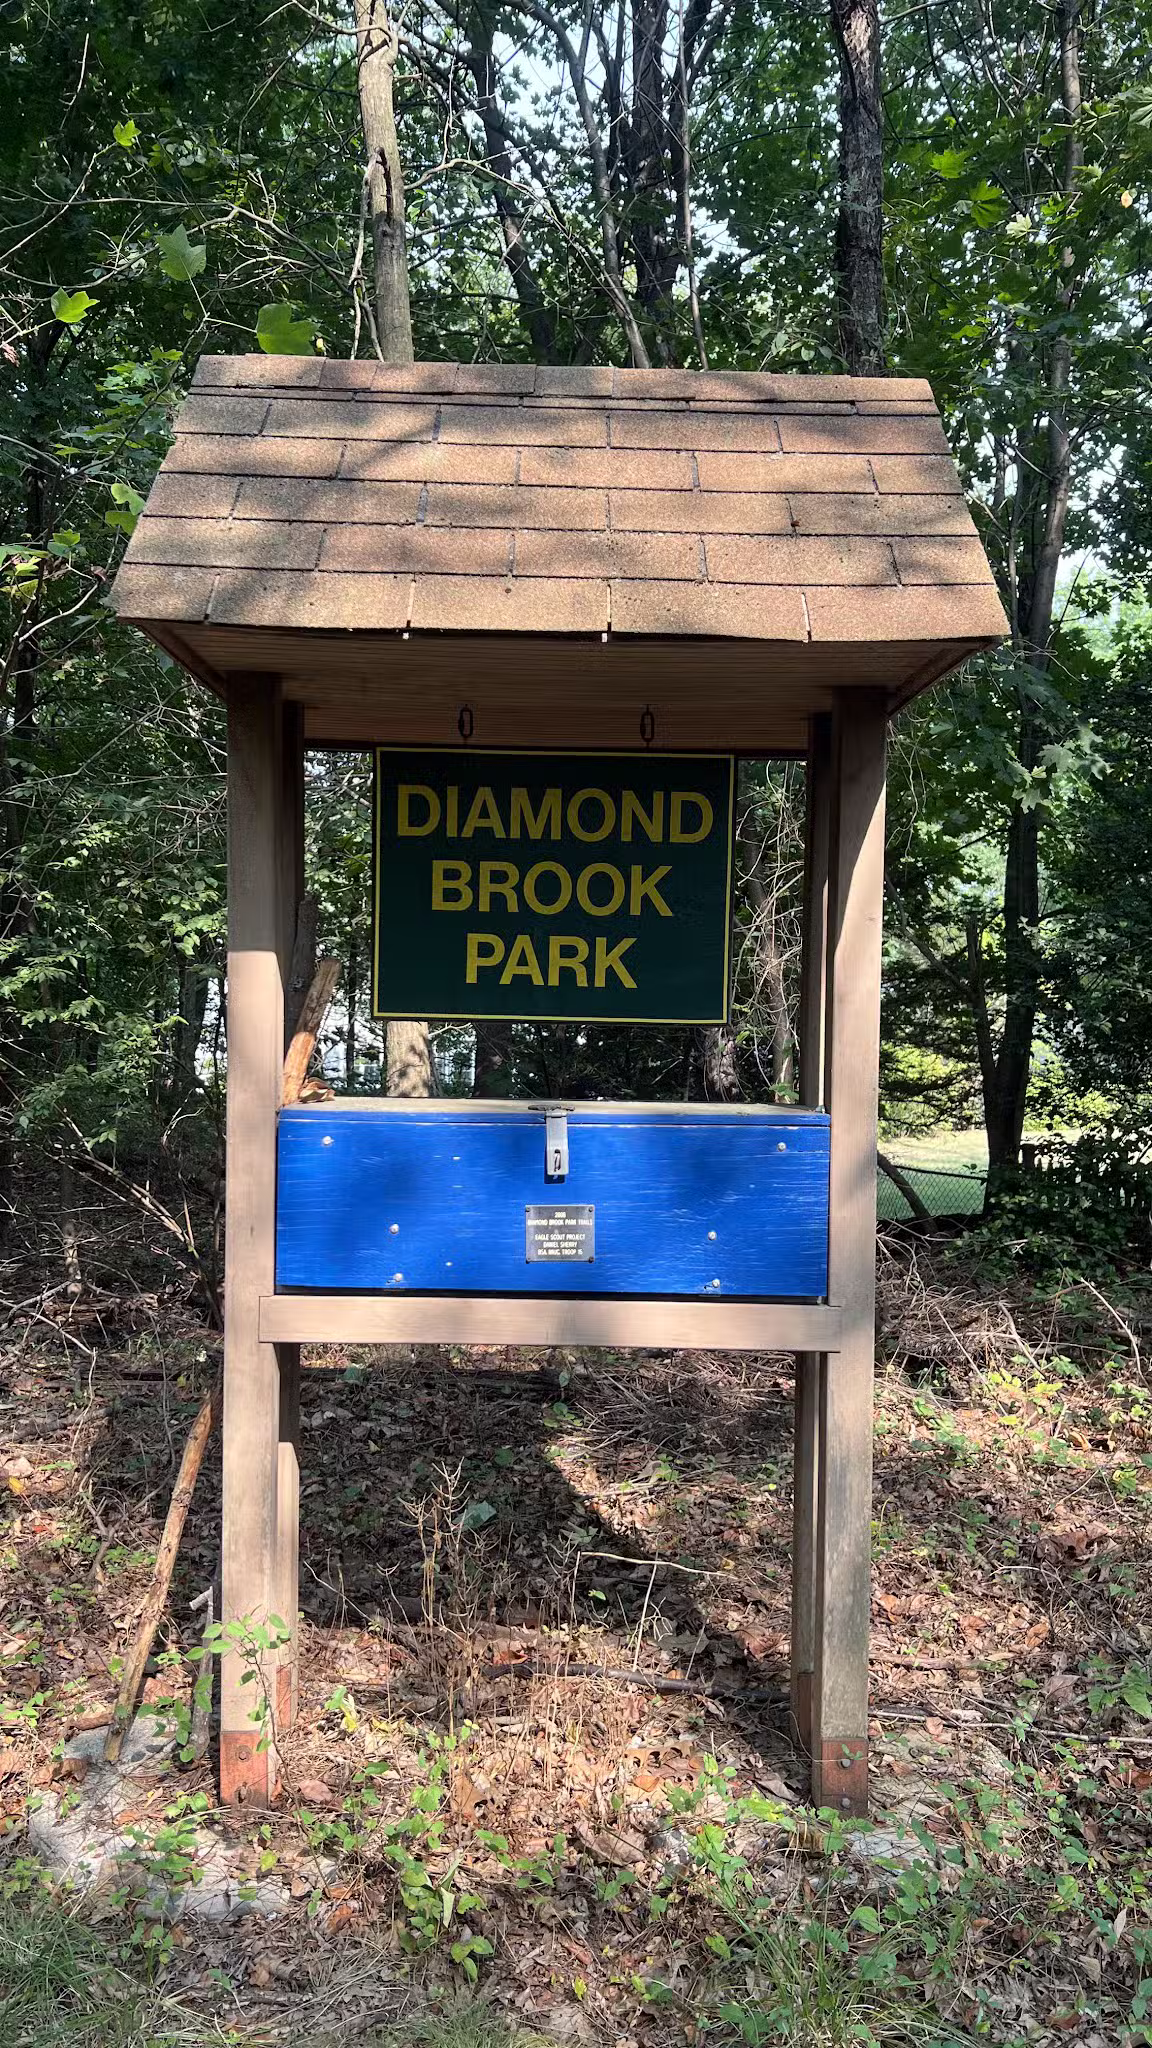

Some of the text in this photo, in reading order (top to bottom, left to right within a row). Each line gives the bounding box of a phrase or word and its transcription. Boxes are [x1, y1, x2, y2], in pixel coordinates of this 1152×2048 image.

[397, 784, 714, 844] DIAMOND
[431, 859, 673, 917] BROOK
[465, 932, 638, 989] PARK
